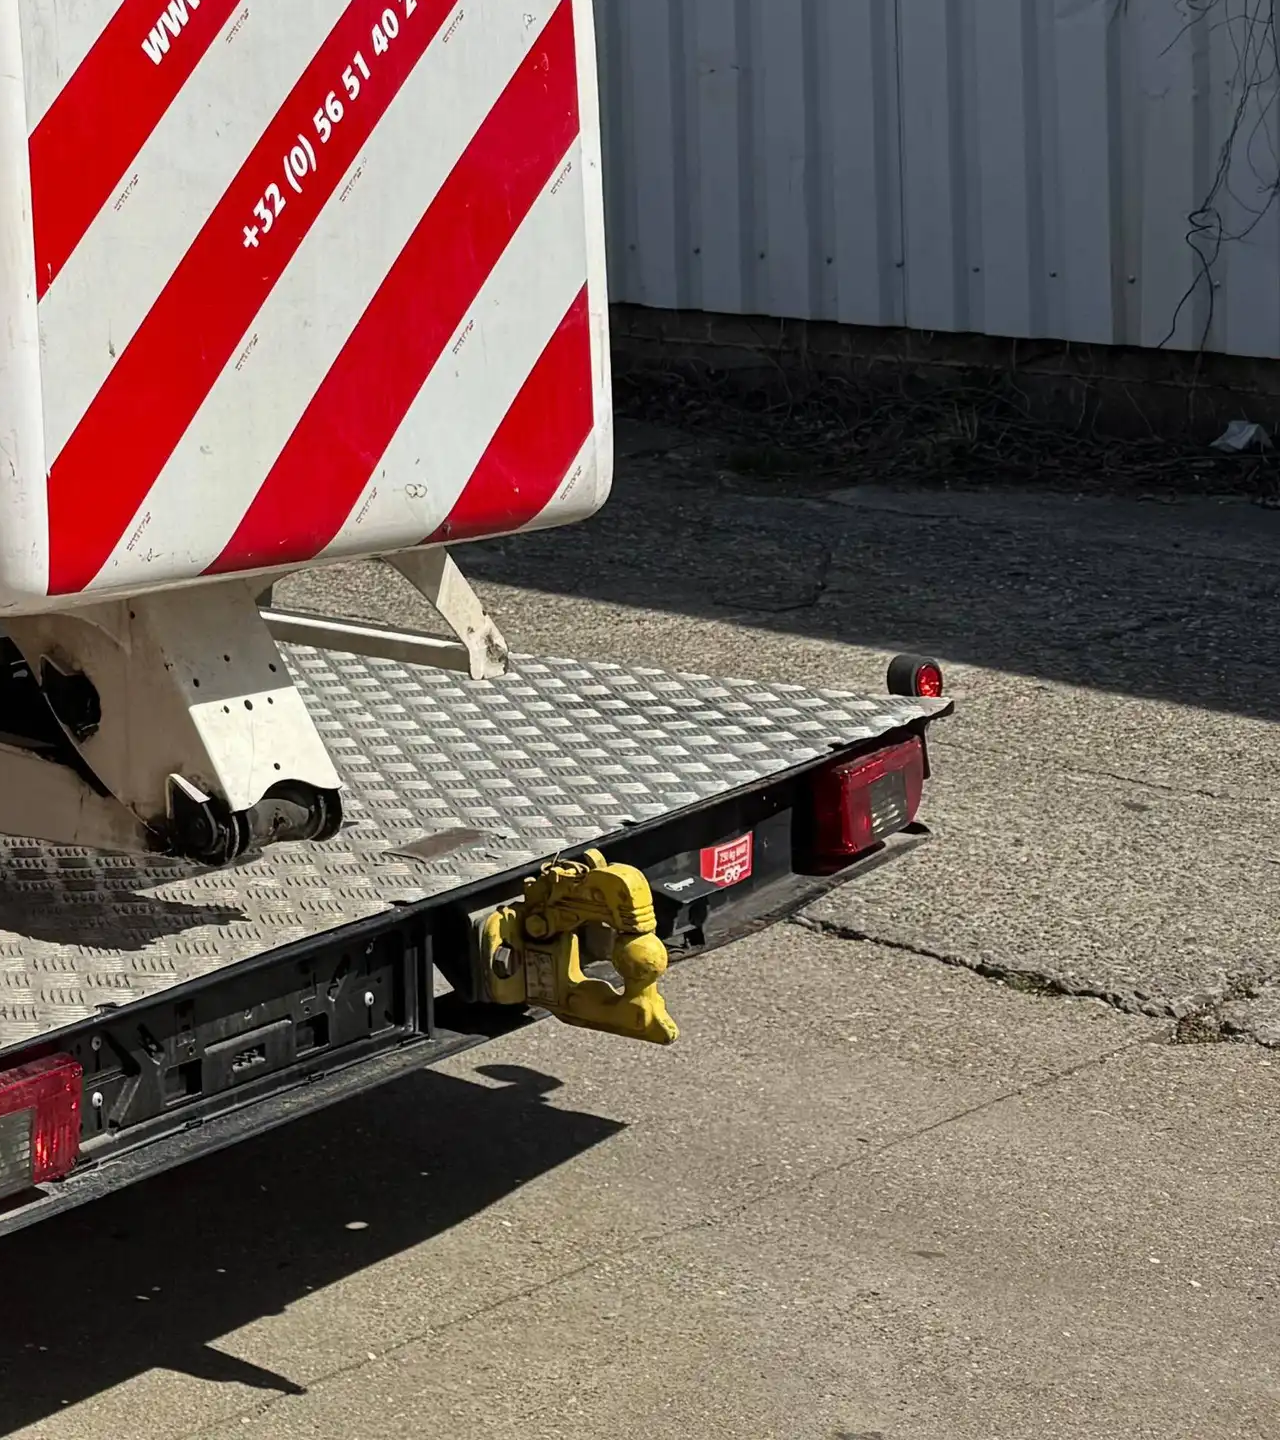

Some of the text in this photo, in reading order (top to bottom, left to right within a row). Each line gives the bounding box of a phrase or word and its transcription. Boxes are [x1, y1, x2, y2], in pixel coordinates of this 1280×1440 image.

[242, 182, 287, 249] +32
[283, 133, 317, 194] (0)
[312, 90, 345, 144] 56
[341, 50, 371, 101] 51
[371, 8, 400, 56] 40
